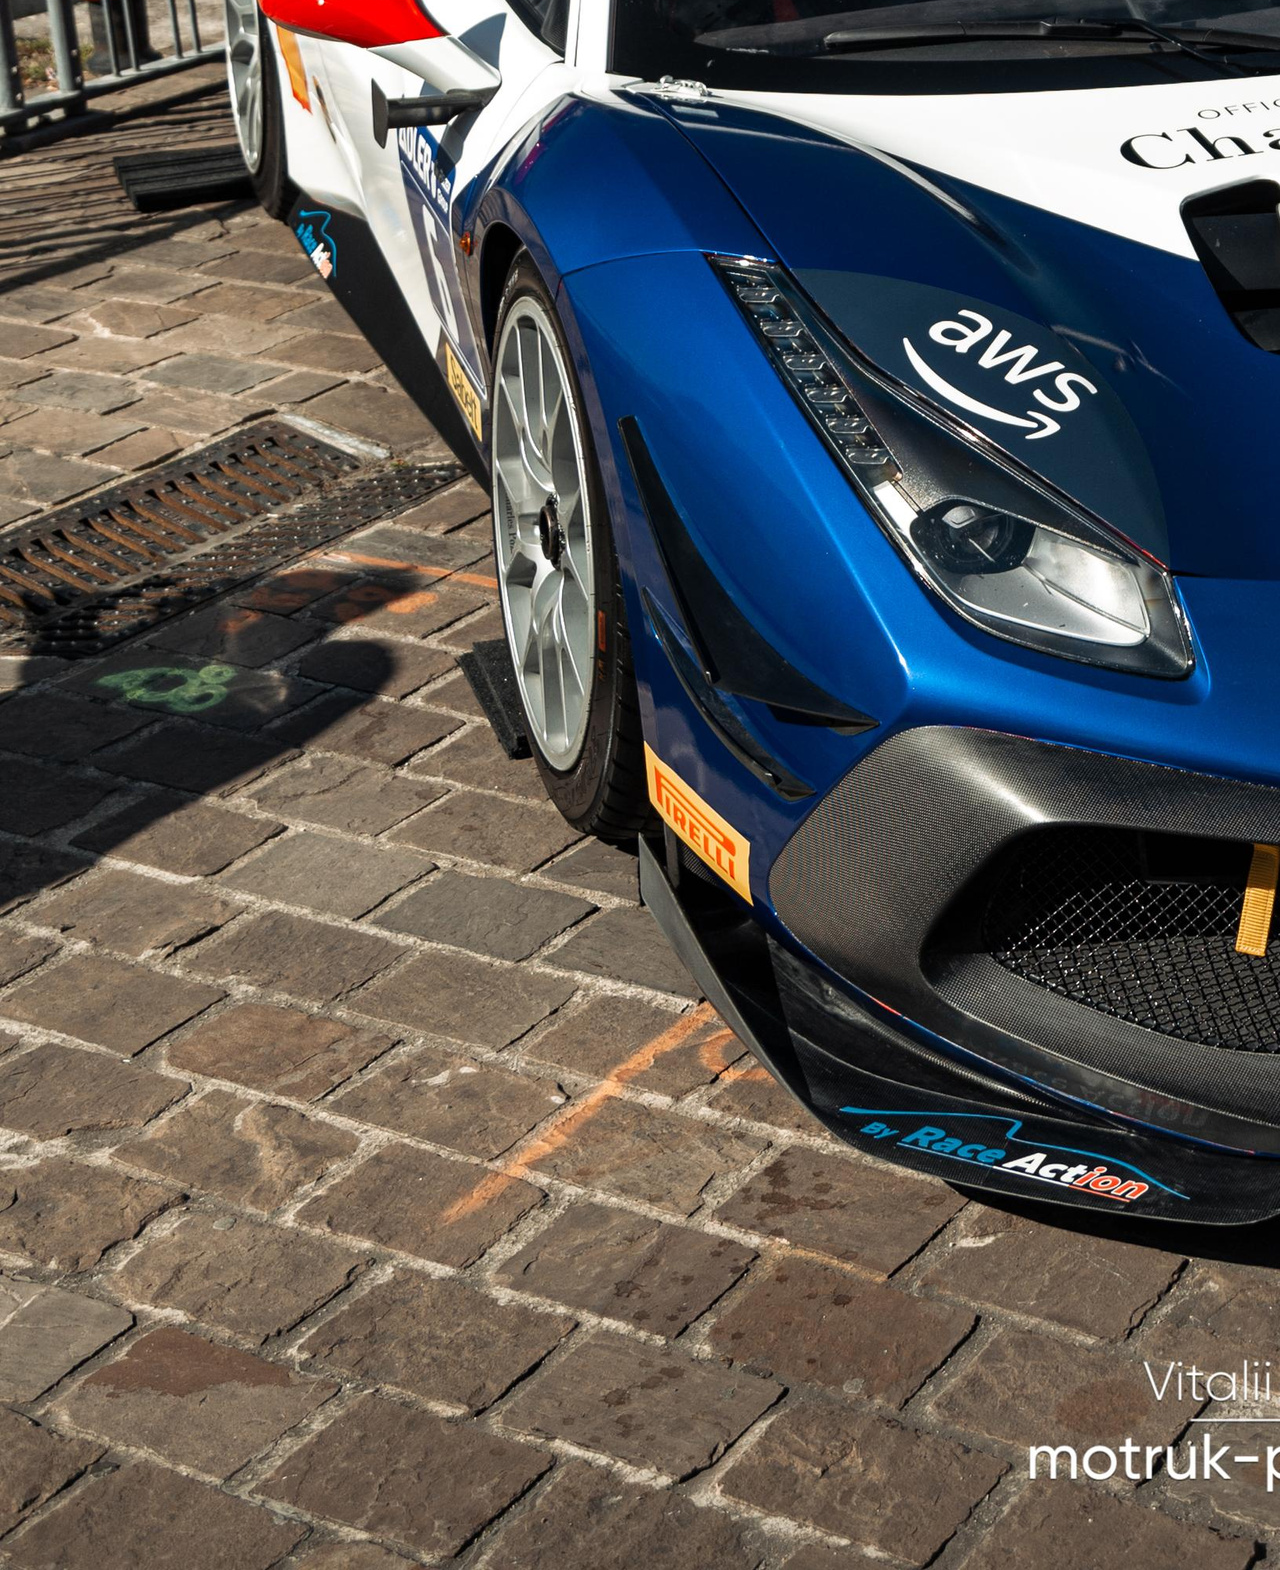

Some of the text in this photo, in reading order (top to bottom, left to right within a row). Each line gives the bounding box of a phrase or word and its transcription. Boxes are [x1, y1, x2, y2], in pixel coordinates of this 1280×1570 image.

[928, 309, 1098, 413] aws
[654, 765, 737, 881] PIRELLI
[860, 1121, 1149, 1200] By Race Action
